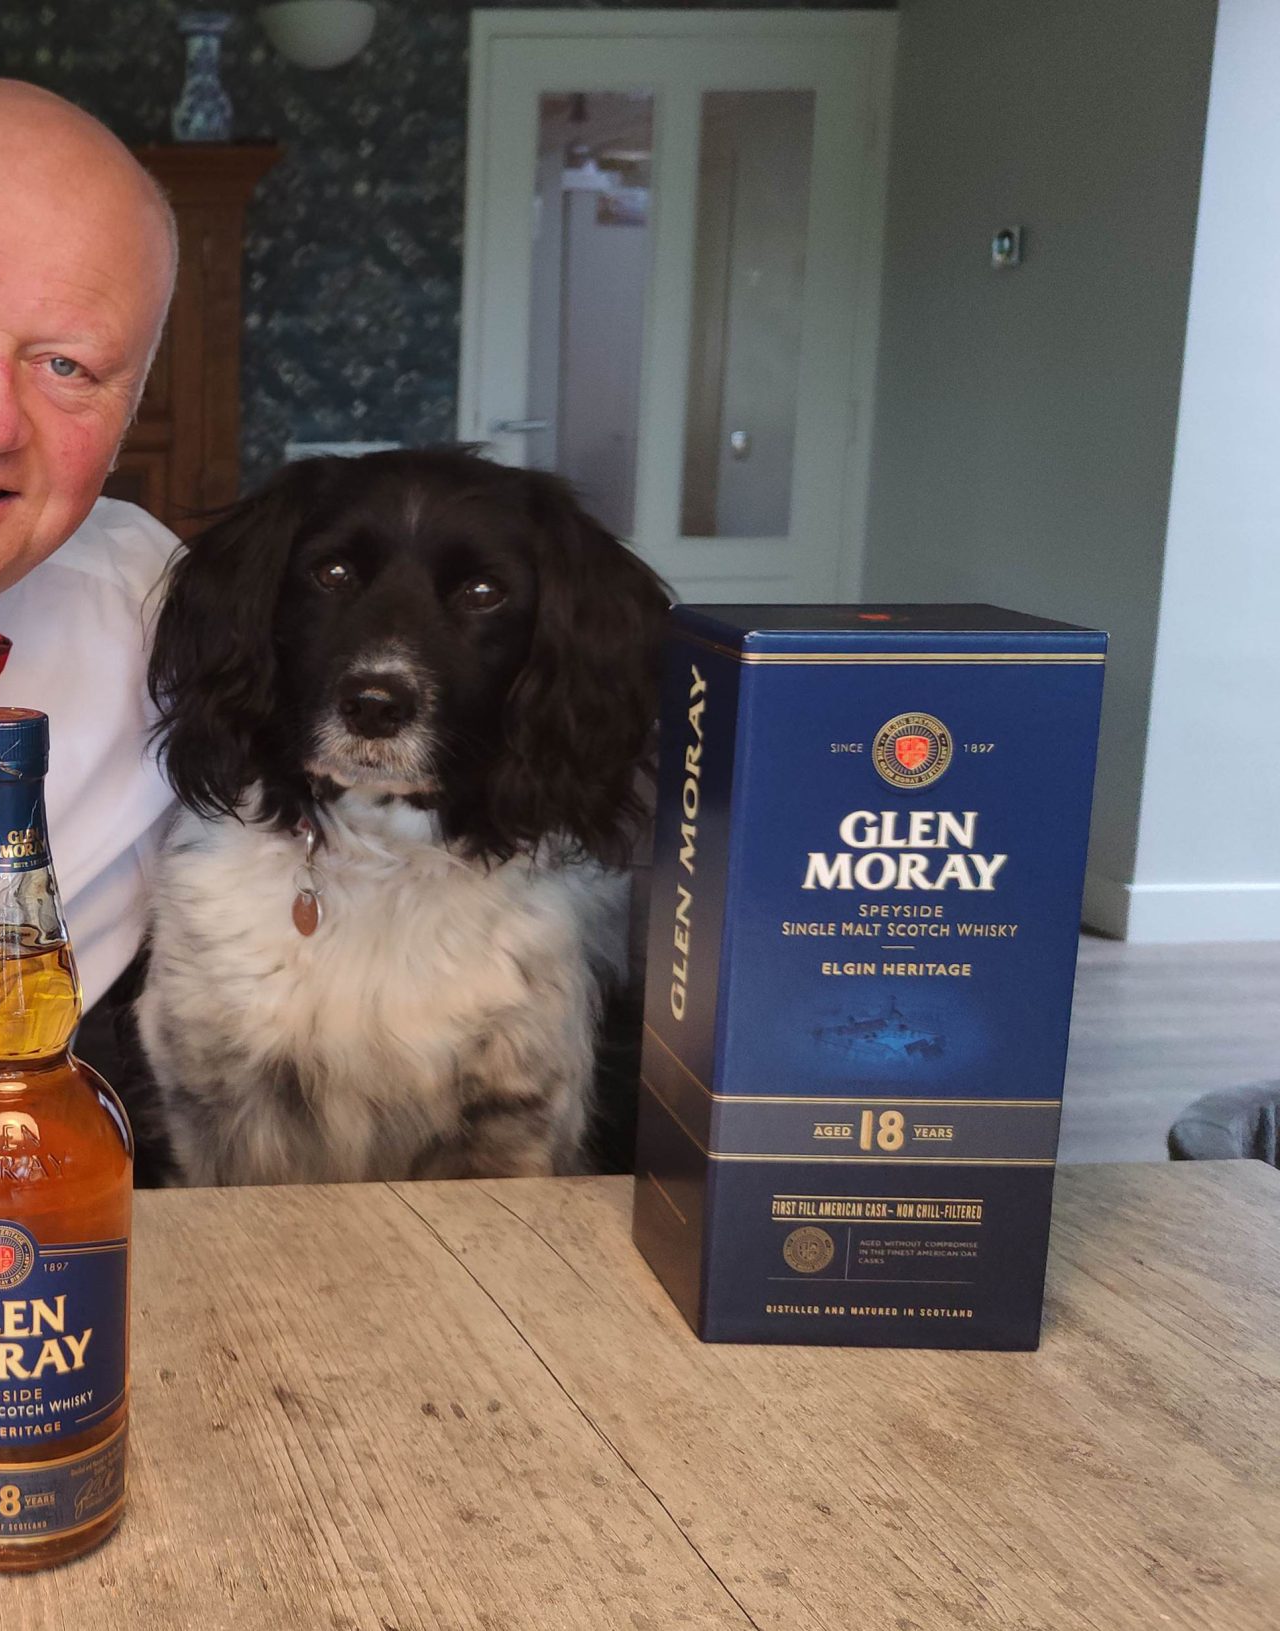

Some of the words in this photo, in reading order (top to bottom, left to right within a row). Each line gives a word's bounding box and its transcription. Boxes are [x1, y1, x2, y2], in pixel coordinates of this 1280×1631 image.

[830, 743, 863, 753] SINCE
[963, 743, 994, 753] 1897
[678, 664, 707, 877] MORAY
[839, 810, 978, 849] GLEN
[801, 852, 1008, 892] MORAY
[858, 904, 944, 918] SPEYSIDE
[782, 921, 836, 936] SINGLE
[841, 921, 882, 936] MALT
[887, 922, 950, 937] SCOTCH
[956, 923, 1018, 938] WHISKY
[670, 883, 694, 1022] GLEN
[821, 962, 876, 975] ELGIN
[882, 963, 972, 976] HERITAGE
[814, 1125, 851, 1138] AGED
[859, 1110, 905, 1151] 18
[913, 1127, 953, 1139] YEARS
[771, 1200, 797, 1216] FIRST
[798, 1201, 817, 1216] FILL
[818, 1202, 863, 1217] AMERICAN
[896, 1204, 914, 1219] NON
[916, 1204, 983, 1220] CHILL-FILTERED
[859, 1239, 882, 1248] AGED
[884, 1240, 922, 1248] WITHOUT
[925, 1241, 978, 1249] COMPROMISE
[43, 1261, 69, 1272] 1897
[766, 1304, 820, 1315] DISTILLED
[824, 1306, 845, 1315] AND
[850, 1306, 898, 1316] MATURED
[903, 1307, 915, 1317] IN
[920, 1308, 973, 1318] SCOTLAND
[49, 1389, 94, 1413] WHISKY
[25, 1494, 56, 1506] YEARS
[8, 1520, 48, 1531] SCOTLAND
